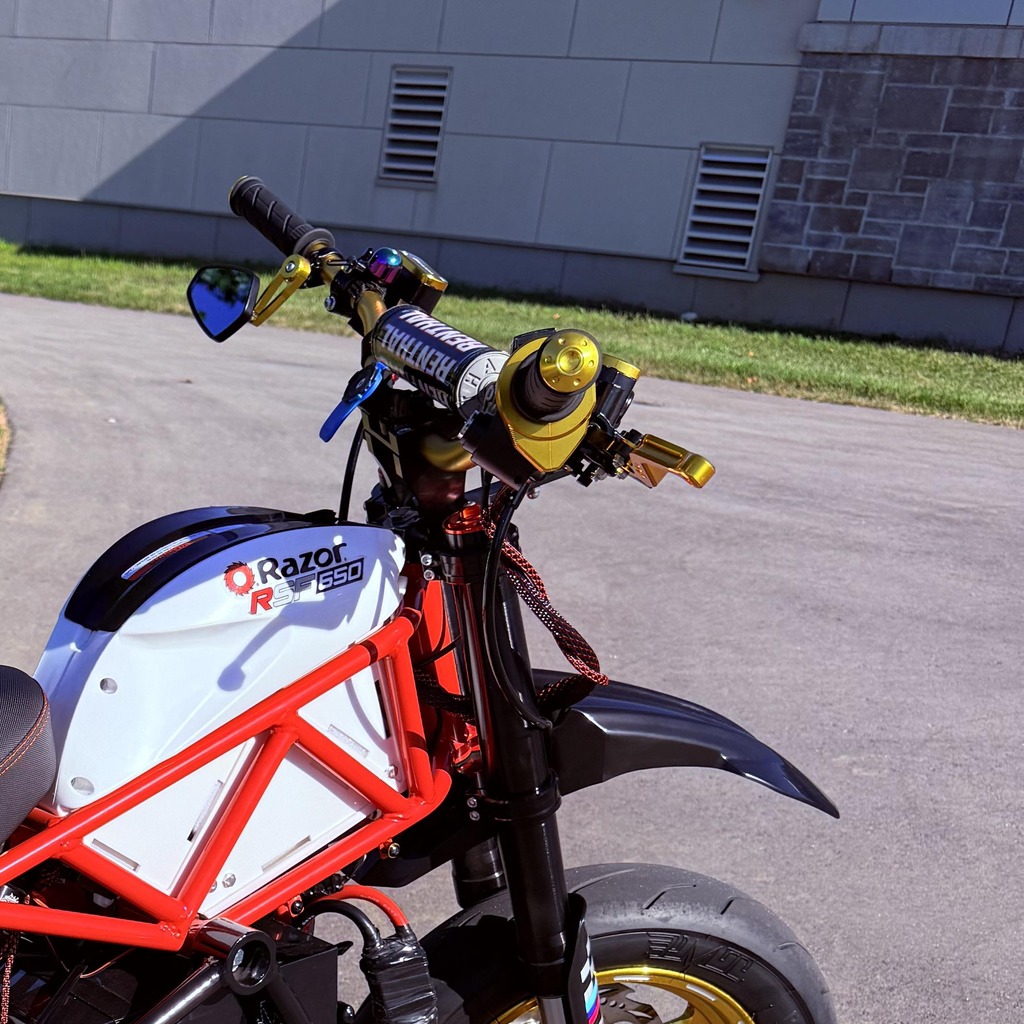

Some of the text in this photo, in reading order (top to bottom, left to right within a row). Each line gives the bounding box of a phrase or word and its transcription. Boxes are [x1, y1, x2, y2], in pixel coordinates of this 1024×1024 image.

[398, 309, 489, 353] RENTHAL
[381, 323, 457, 384] RENTHAL
[257, 543, 347, 584] Razor
